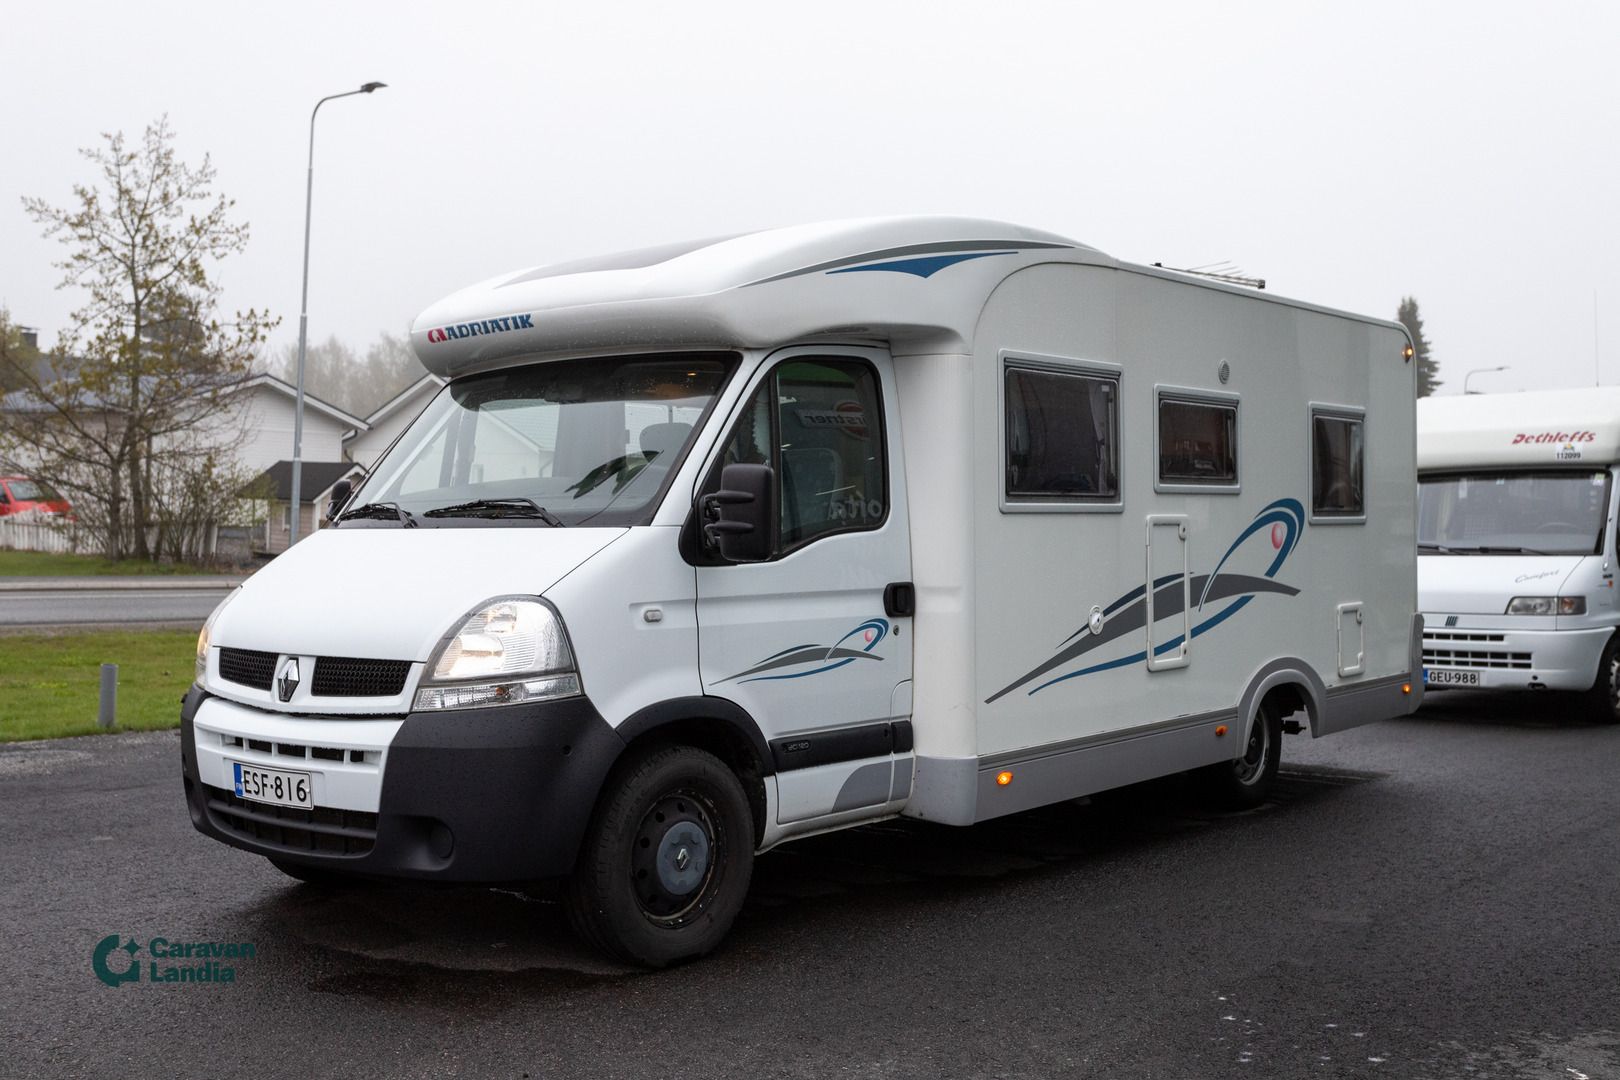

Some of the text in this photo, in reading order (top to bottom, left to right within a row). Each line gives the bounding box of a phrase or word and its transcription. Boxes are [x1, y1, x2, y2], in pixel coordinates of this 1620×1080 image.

[445, 313, 534, 341] ADRIATIK
[1512, 431, 1596, 444] Dethleffs
[1429, 671, 1477, 685] GEU-988
[243, 769, 307, 803] ESF-816
